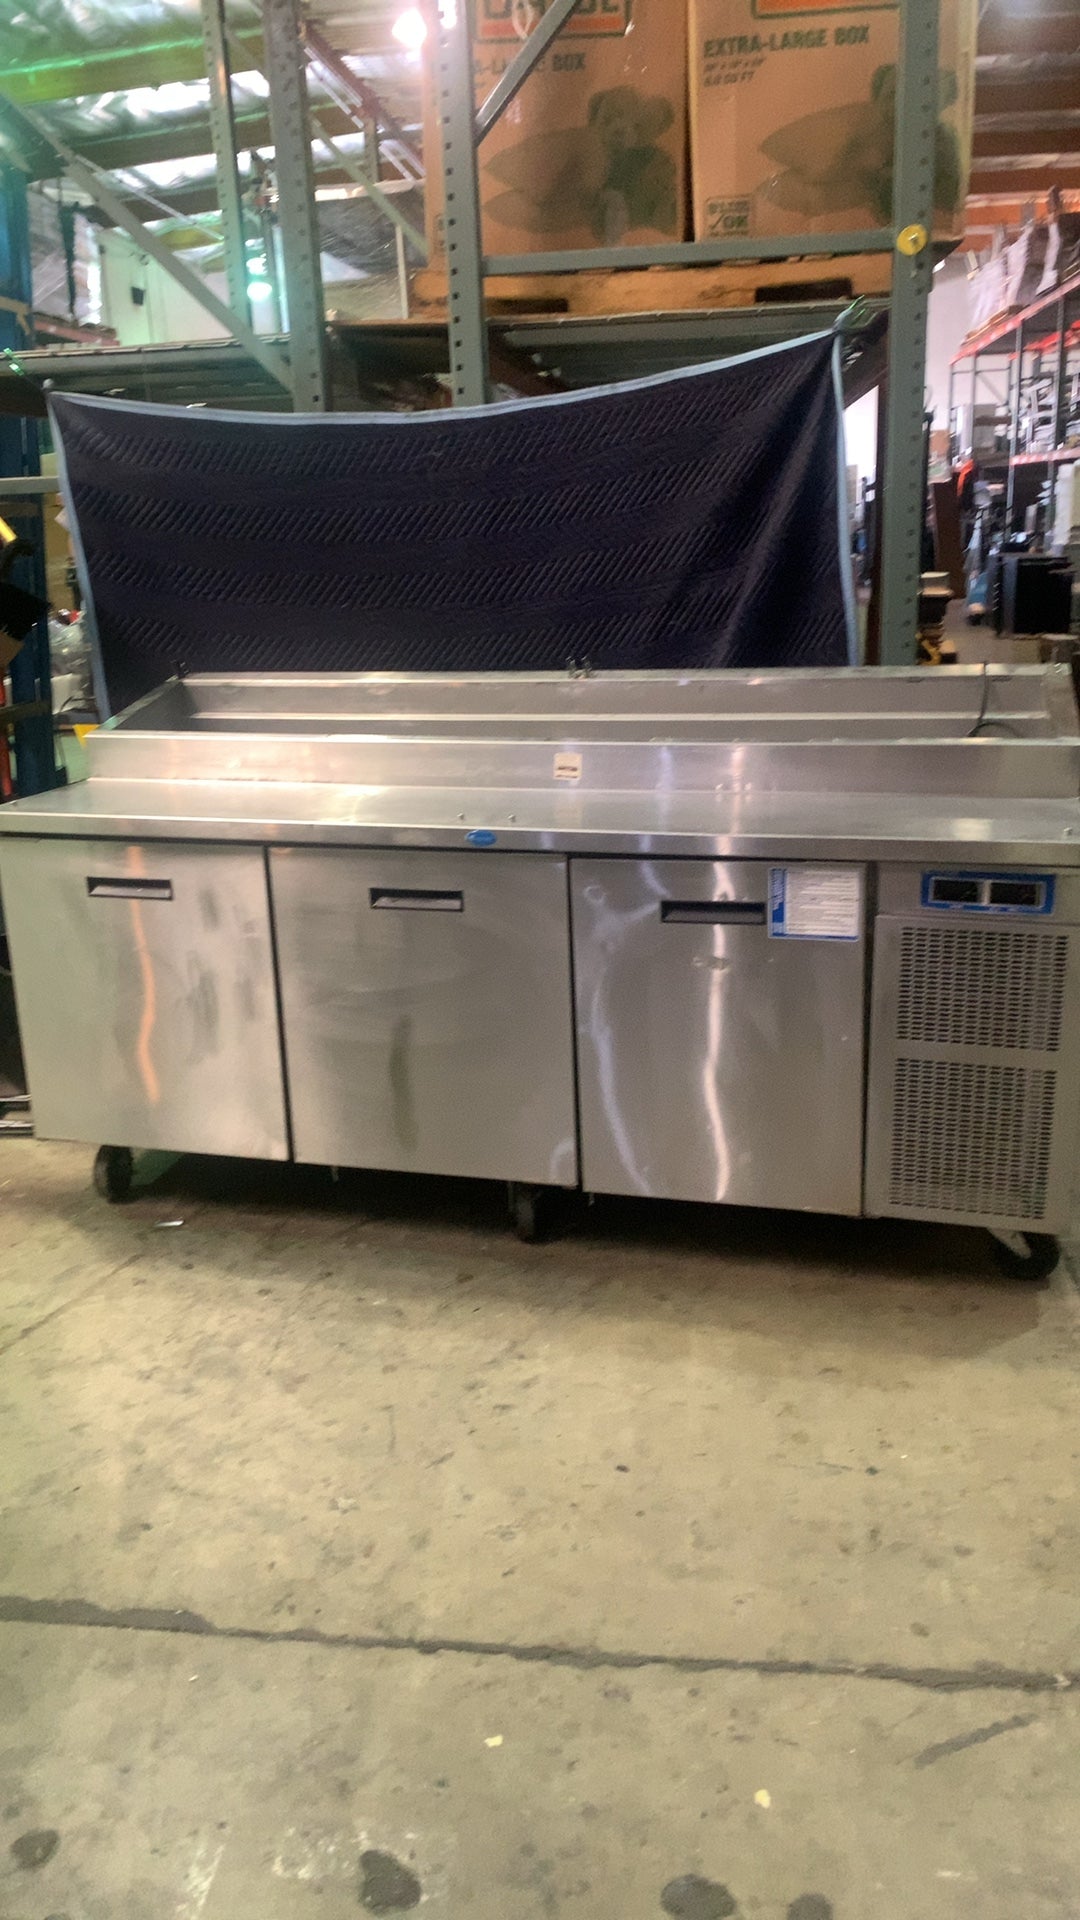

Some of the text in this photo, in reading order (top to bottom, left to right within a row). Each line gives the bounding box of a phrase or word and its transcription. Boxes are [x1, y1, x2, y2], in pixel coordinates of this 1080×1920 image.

[704, 25, 869, 57] EXTRA-LARGE BOX
[553, 53, 586, 71] BOX
